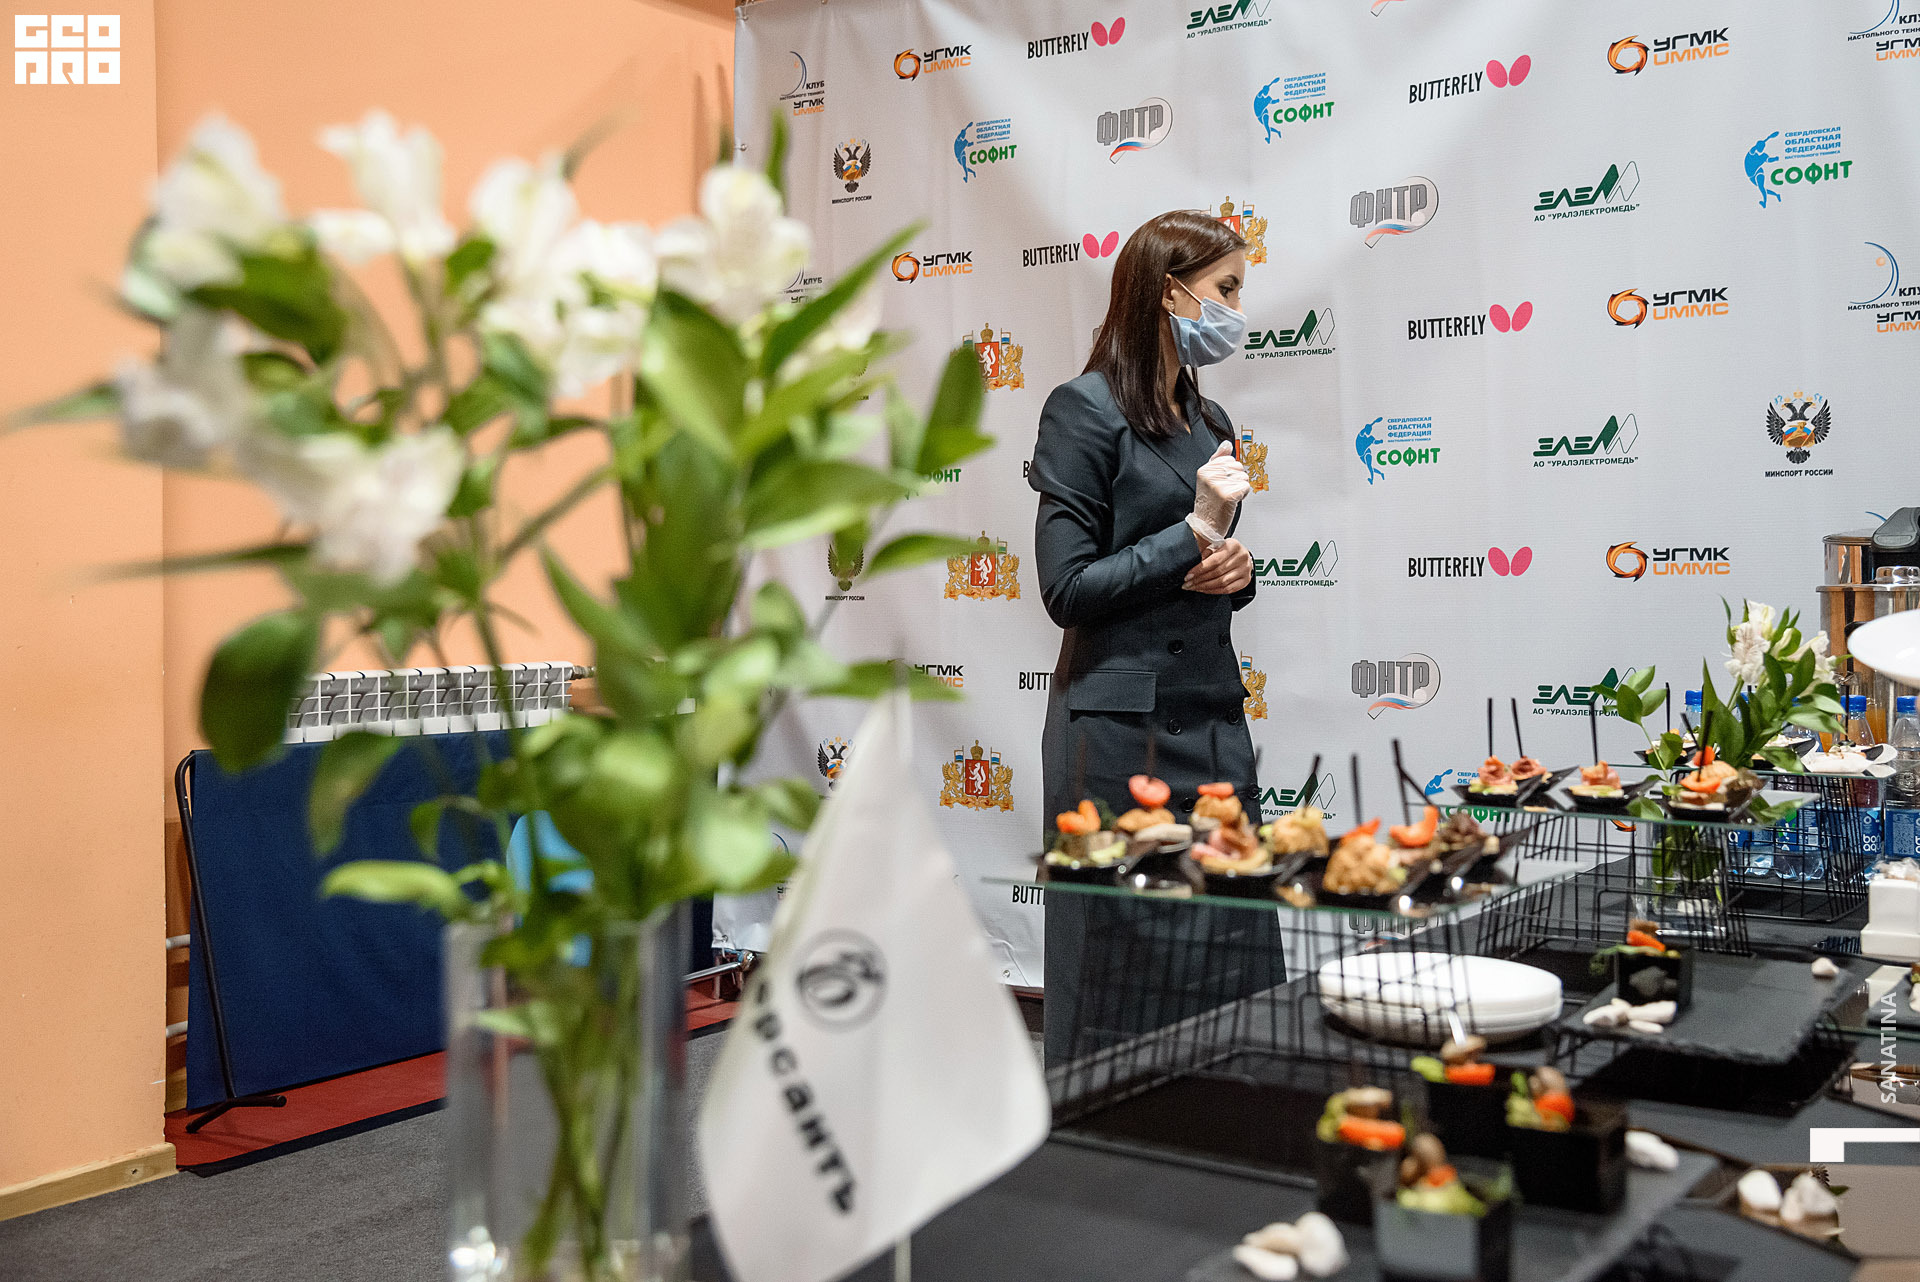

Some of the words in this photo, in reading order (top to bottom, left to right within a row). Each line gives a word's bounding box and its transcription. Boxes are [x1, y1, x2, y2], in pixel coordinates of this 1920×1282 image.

[1027, 32, 1089, 60] BUTTERFLY
[1653, 26, 1730, 52] УГМК
[924, 45, 972, 62] УГМК
[1653, 42, 1730, 67] UMMC
[924, 57, 971, 74] UMMC
[806, 80, 825, 90] КЛУБ
[1284, 78, 1326, 90] ОБЛАСТНАЯ
[1284, 85, 1326, 97] ФЕДЕРАЦИЯ
[1409, 71, 1484, 105] BUTTERFLY
[794, 97, 825, 109] УГМК
[794, 105, 825, 116] UMMC
[1273, 102, 1335, 124] СОФНТ
[1097, 105, 1164, 146] ФНТР
[1785, 126, 1841, 138] СВЕРДЛОВСКАЯ
[1785, 133, 1841, 146] ОБЛАСТНАЯ
[969, 144, 1017, 165] СОФНТ
[1785, 141, 1841, 154] ФЕДЕРАЦИЯ
[1770, 160, 1853, 186] СОФНТ
[856, 194, 872, 203] РОССИИ
[1349, 183, 1428, 230] ФНТР
[1534, 214, 1546, 223] АО
[923, 251, 972, 266] УГМК
[1022, 242, 1081, 268] BUTTERFLY
[923, 263, 973, 278] UMMC
[1653, 286, 1729, 307] УГМК
[1653, 302, 1729, 320] UMMC
[1407, 314, 1486, 341] BUTTERFLY
[1245, 352, 1255, 360] АО
[1387, 422, 1432, 431] ОБЛАСТНАЯ
[1387, 430, 1432, 438] ФЕДЕРАЦИЯ
[1376, 447, 1441, 467] СОФНТ
[1533, 459, 1545, 468] АО
[1764, 470, 1802, 478] МИНСПОРТ
[1804, 468, 1834, 477] РОССИИ
[1652, 546, 1730, 561] УГМК
[1407, 556, 1486, 578] BUTTERFLY
[1653, 561, 1731, 576] UMMC
[1351, 660, 1430, 699] ФНТР
[1533, 708, 1544, 716] АО
